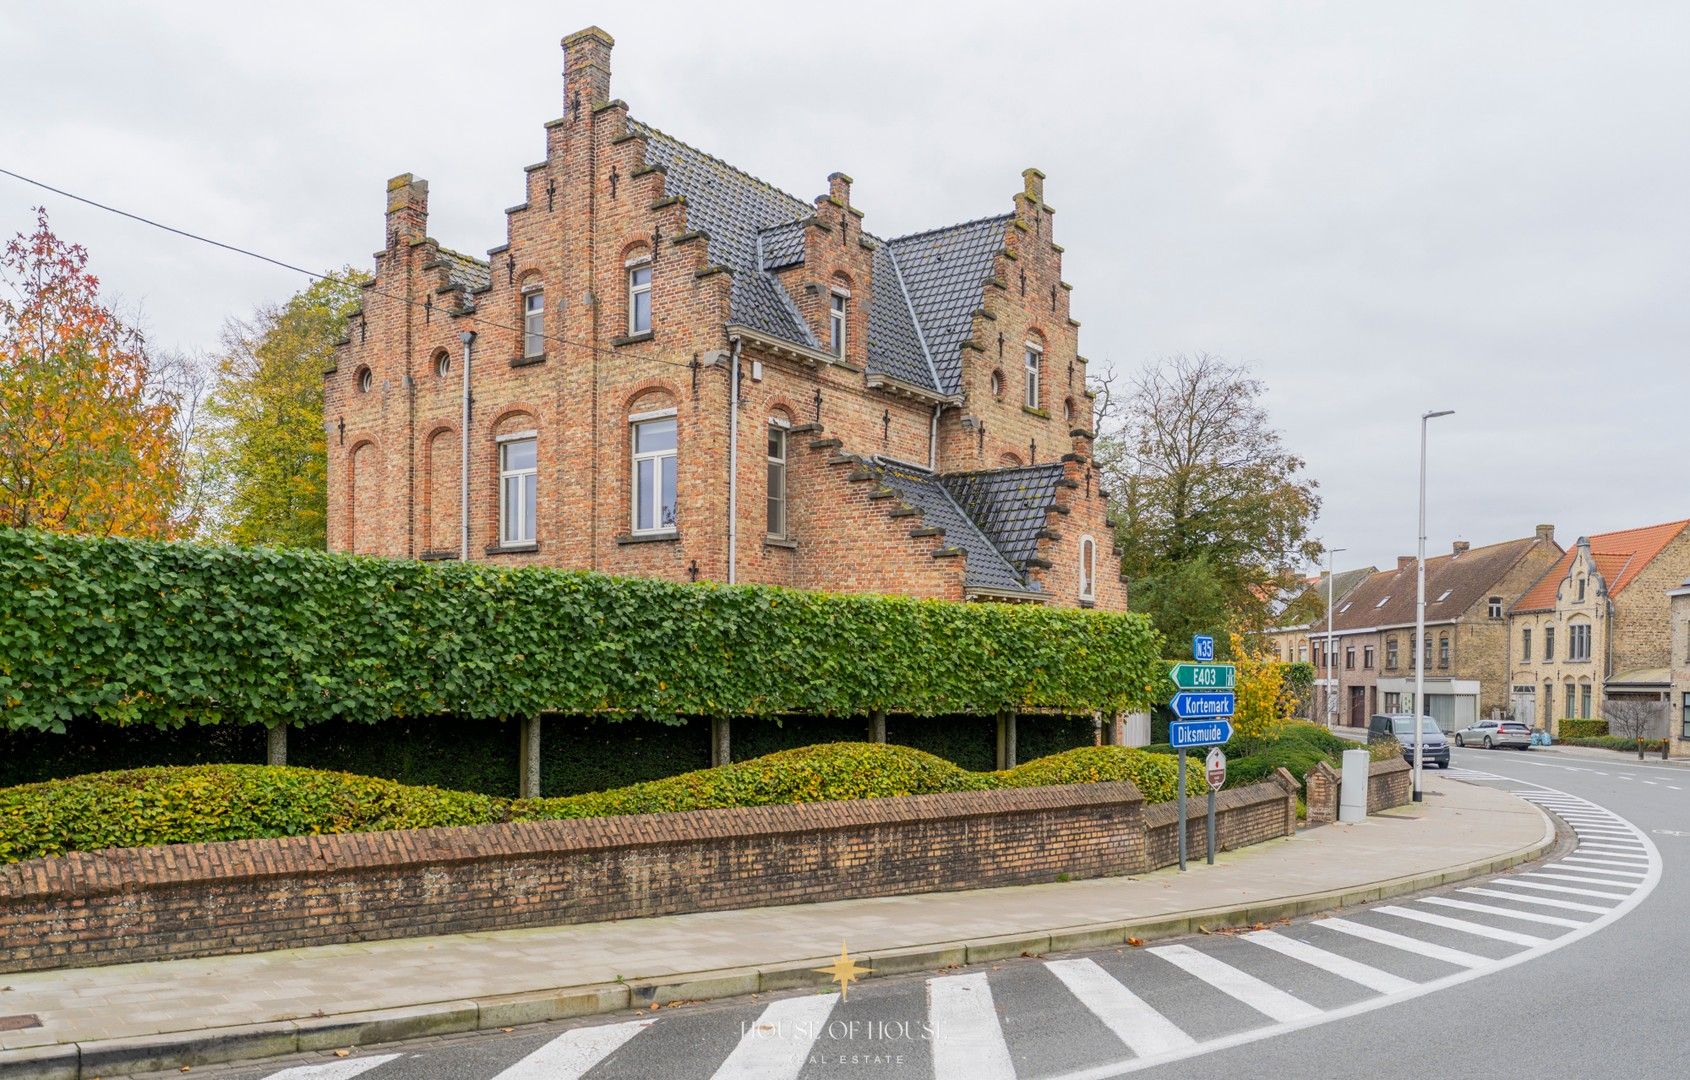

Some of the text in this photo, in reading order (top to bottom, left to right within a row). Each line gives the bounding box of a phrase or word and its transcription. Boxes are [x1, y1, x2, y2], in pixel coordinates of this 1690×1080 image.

[1197, 640, 1212, 657] N35
[1193, 668, 1216, 685] E403
[1185, 696, 1229, 714] Kortemark
[1178, 725, 1221, 743] Diksmuide
